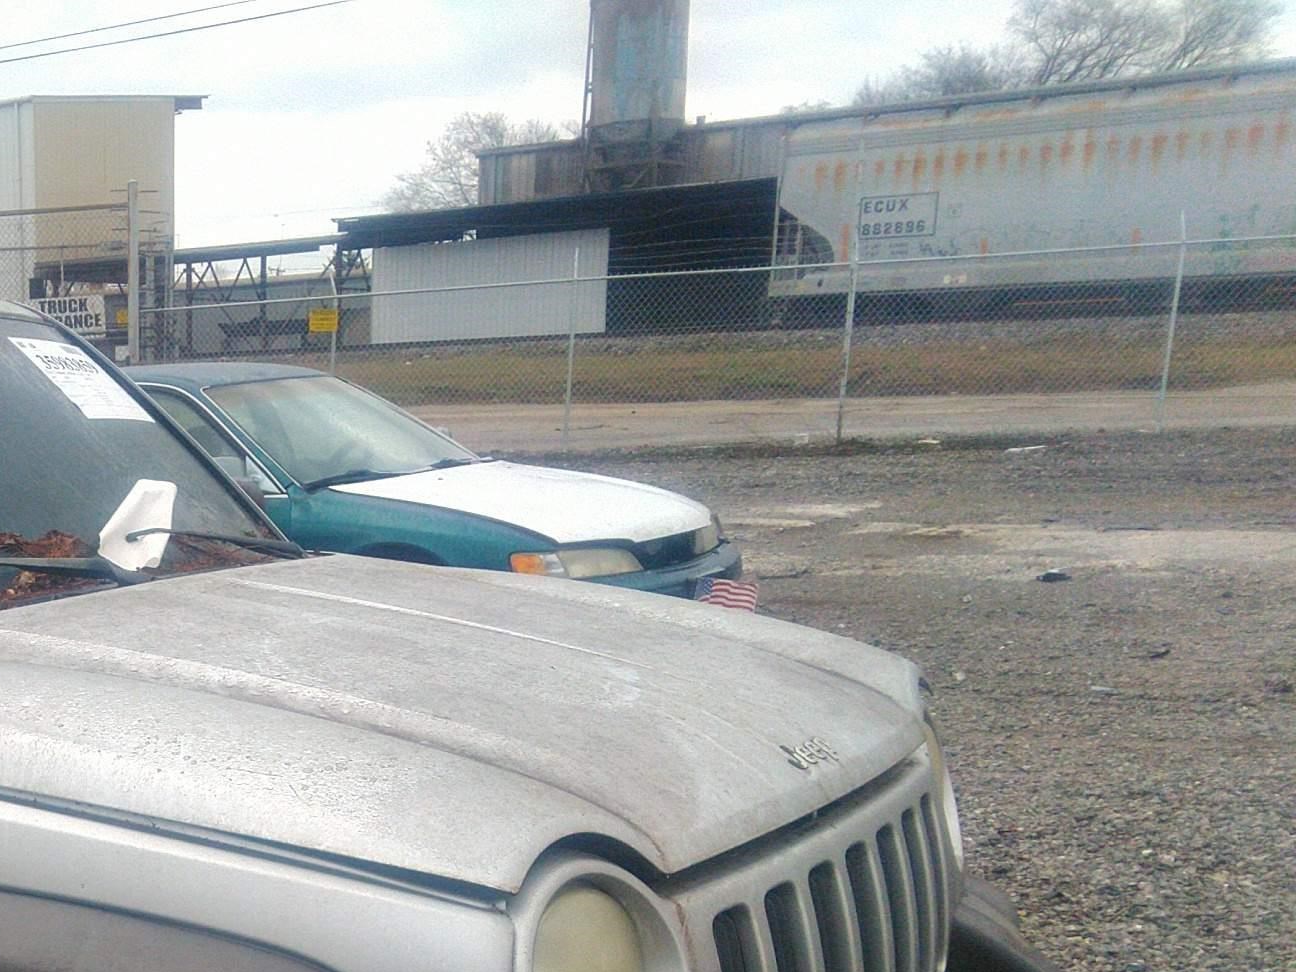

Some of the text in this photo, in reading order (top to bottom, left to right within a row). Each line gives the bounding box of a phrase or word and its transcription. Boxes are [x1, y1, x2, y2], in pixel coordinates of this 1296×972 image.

[864, 199, 910, 213] ECUX
[38, 298, 89, 314] TRUCK
[779, 736, 839, 770] Jeep
